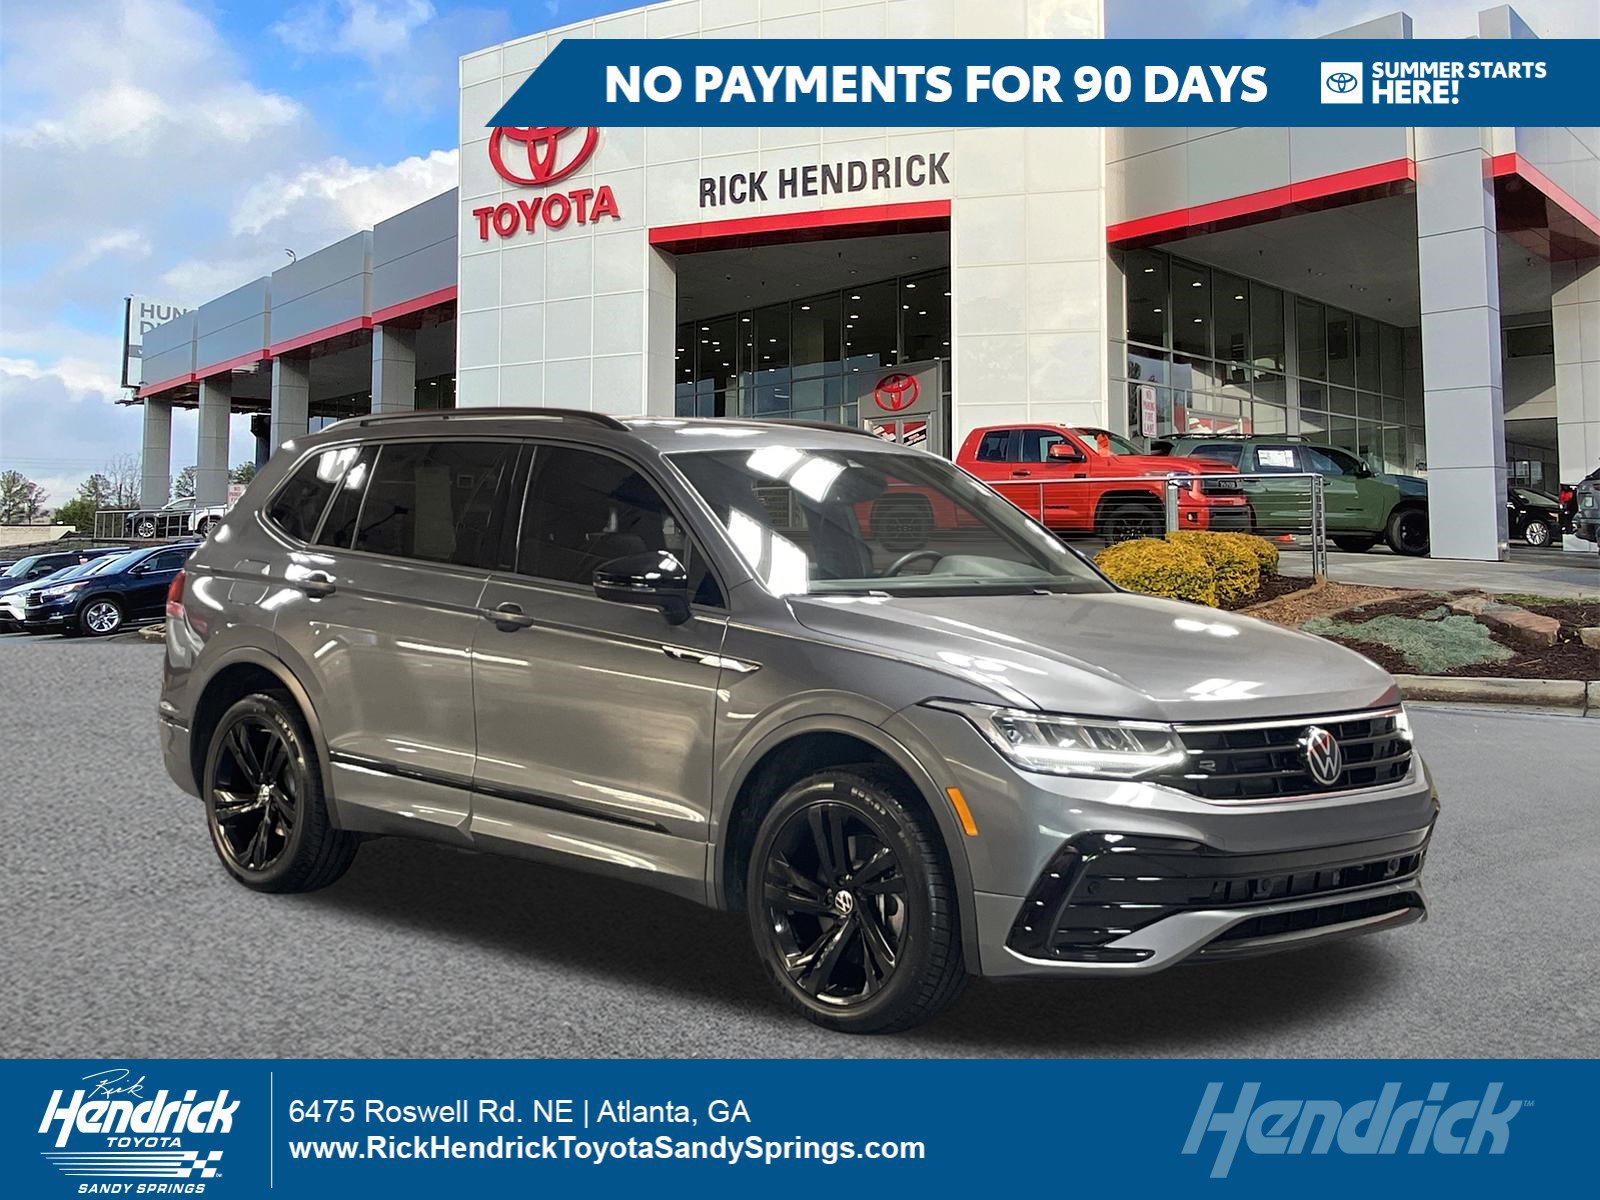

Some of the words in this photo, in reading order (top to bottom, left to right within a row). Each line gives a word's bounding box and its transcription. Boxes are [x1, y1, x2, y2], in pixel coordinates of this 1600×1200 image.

[699, 170, 769, 208] RICK
[778, 151, 950, 199] HENDRICK
[473, 185, 621, 241] TOYOTA
